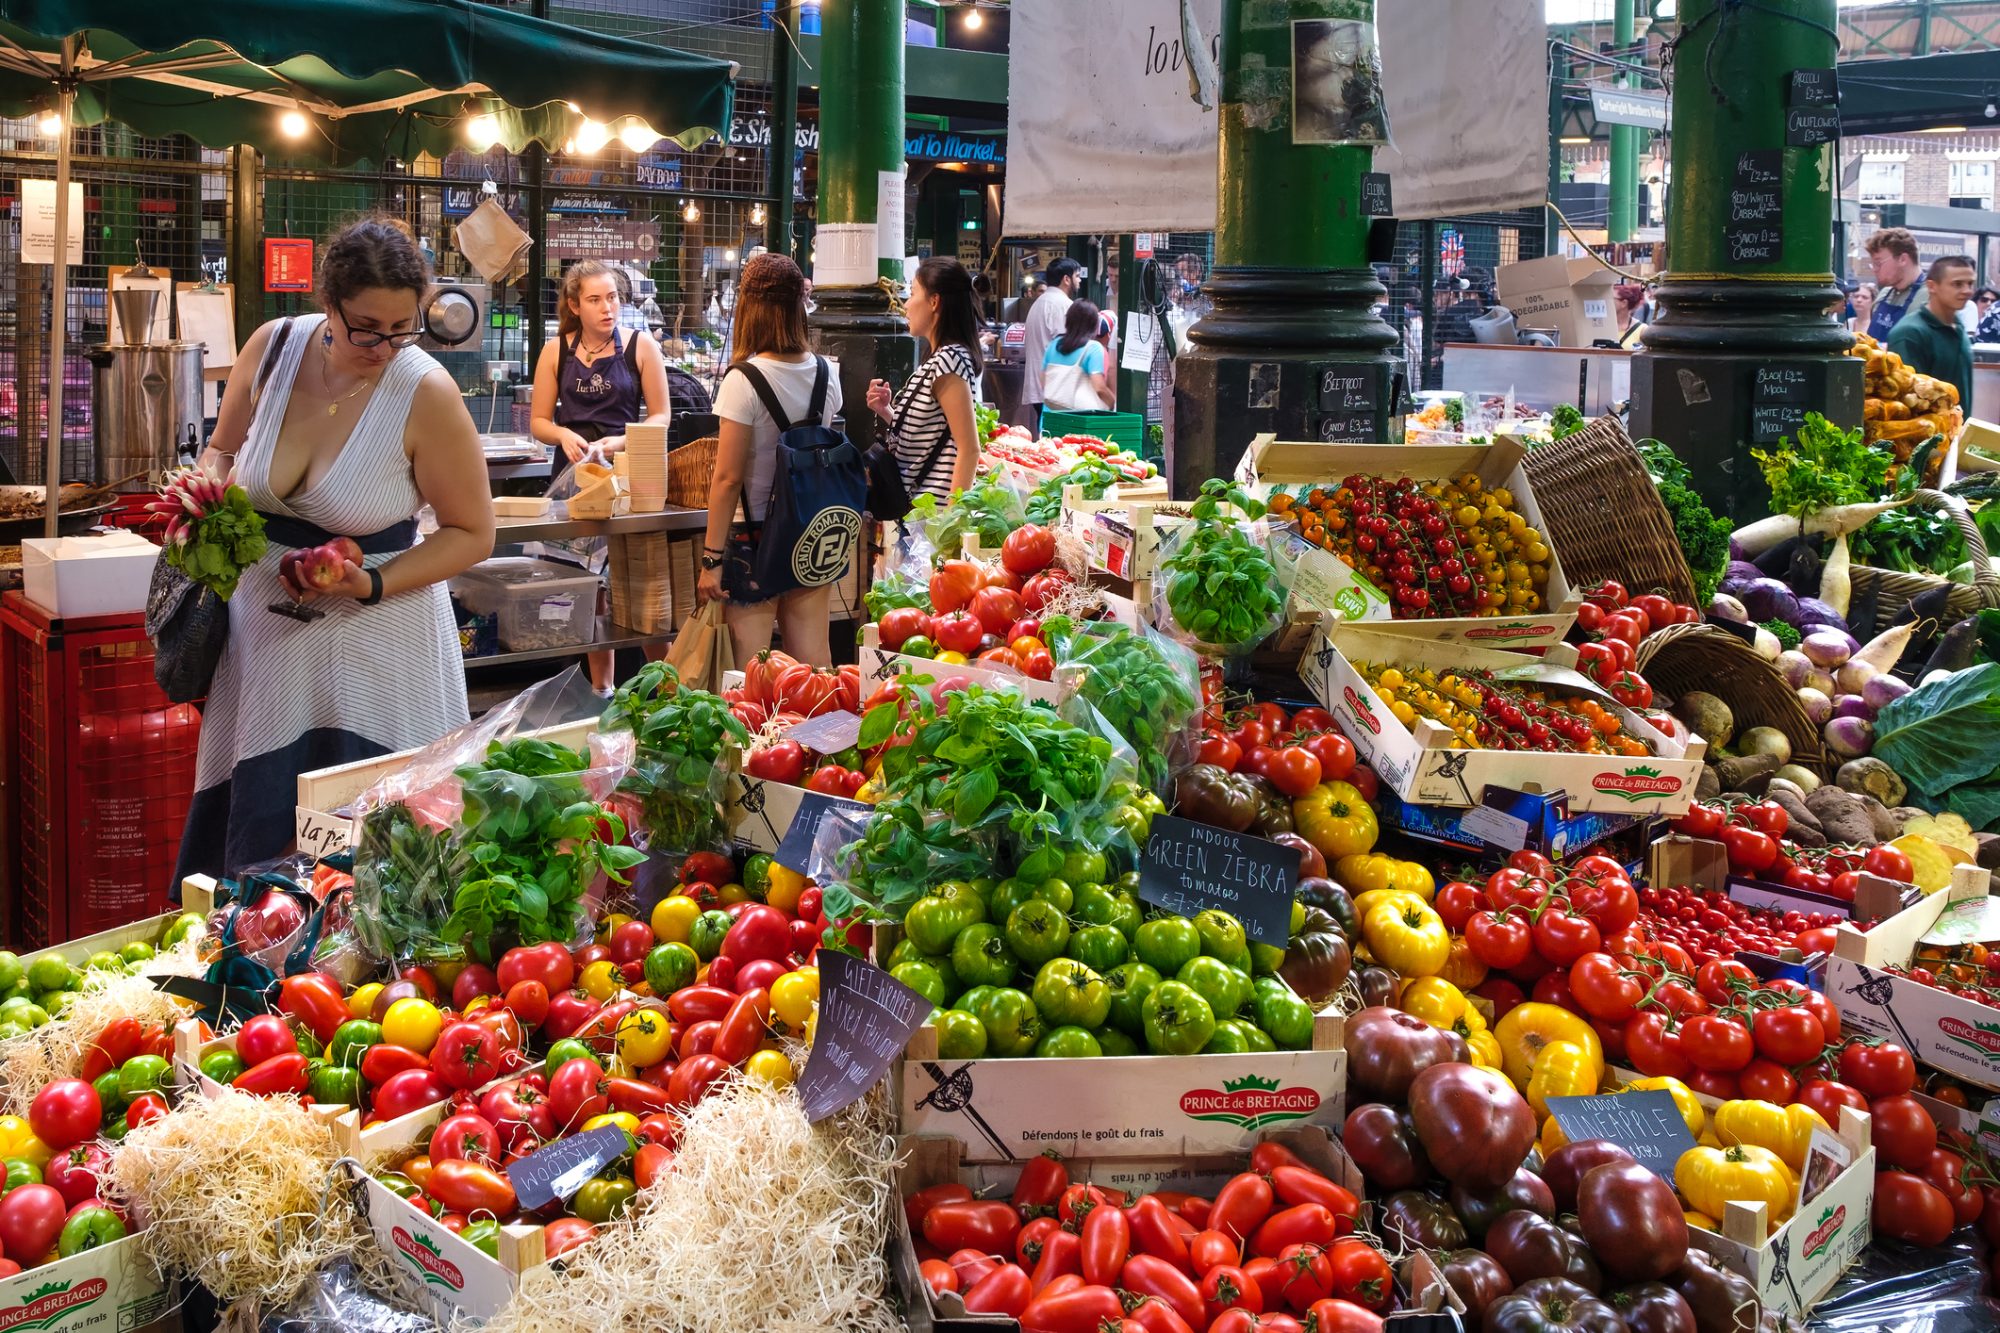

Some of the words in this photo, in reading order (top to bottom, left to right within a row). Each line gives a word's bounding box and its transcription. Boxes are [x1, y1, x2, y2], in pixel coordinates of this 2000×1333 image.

[1145, 26, 1184, 76] lov
[1789, 110, 1839, 131] CAULIFLOWER
[904, 134, 925, 155] oat
[926, 134, 941, 157] To
[637, 165, 656, 183] DAY
[657, 168, 682, 185] BOAT
[1512, 299, 1570, 316] ODEGRADABLE
[1524, 294, 1544, 304] 100%
[1323, 370, 1365, 393] BEETROOT
[1757, 368, 1782, 384] BLACK
[1754, 406, 1780, 418] WHITE
[1321, 418, 1346, 436] CANDY
[798, 540, 814, 575] FENDI
[810, 513, 840, 539] ROMA
[1337, 593, 1363, 616] SANS
[1467, 629, 1494, 637] PRINCE
[1507, 627, 1552, 635] BRETAGNE
[1344, 687, 1358, 705] PRINCE
[1360, 706, 1381, 733] BRETAGNE
[1594, 776, 1625, 788] PRINCE
[1625, 780, 1634, 788] de
[1634, 779, 1680, 791] BRETAGNE
[301, 816, 323, 841] la
[1191, 827, 1242, 853] INDOOR
[1408, 822, 1451, 840] COOPERATIVA
[1452, 834, 1485, 848] AGRICOLA
[1148, 833, 1208, 875] GREEN
[1222, 853, 1287, 894] ZEBRA
[1180, 872, 1239, 902] tomatoes
[825, 987, 864, 1039] Mixed
[860, 1012, 900, 1062] Heirloom
[1940, 1020, 1978, 1041] PRINCE
[1978, 1034, 1989, 1045] de
[1935, 1042, 1979, 1065] Défendons
[1981, 1059, 1990, 1068] le
[1991, 1063, 2000, 1072] go
[1184, 1095, 1230, 1110] PRINCE
[1232, 1096, 1245, 1109] de
[1246, 1094, 1316, 1109] BRETAGNE
[1580, 1096, 1626, 1112] INDOOR
[1022, 1129, 1078, 1141] Défendons
[1081, 1129, 1092, 1140] le
[1095, 1128, 1119, 1142] goût
[1123, 1129, 1137, 1139] du
[1139, 1128, 1164, 1139] frais
[1559, 1109, 1678, 1140] PINEAPPLE
[520, 1130, 618, 1192] HEIRLOOM
[1111, 1171, 1136, 1183] frais
[1138, 1171, 1152, 1182] du
[1154, 1170, 1179, 1183] goût
[1181, 1169, 1192, 1180] le
[1803, 1234, 1819, 1255] PRINCE
[1823, 1211, 1846, 1237] BRETAGNE
[393, 1230, 418, 1257] PRINCE
[418, 1250, 425, 1259] de
[424, 1252, 462, 1287] BRETAGNE
[0, 1307, 29, 1326] INCE
[30, 1306, 42, 1317] de
[43, 1282, 103, 1311] BRETAGNE
[71, 1319, 84, 1330] du
[85, 1311, 108, 1328] frais
